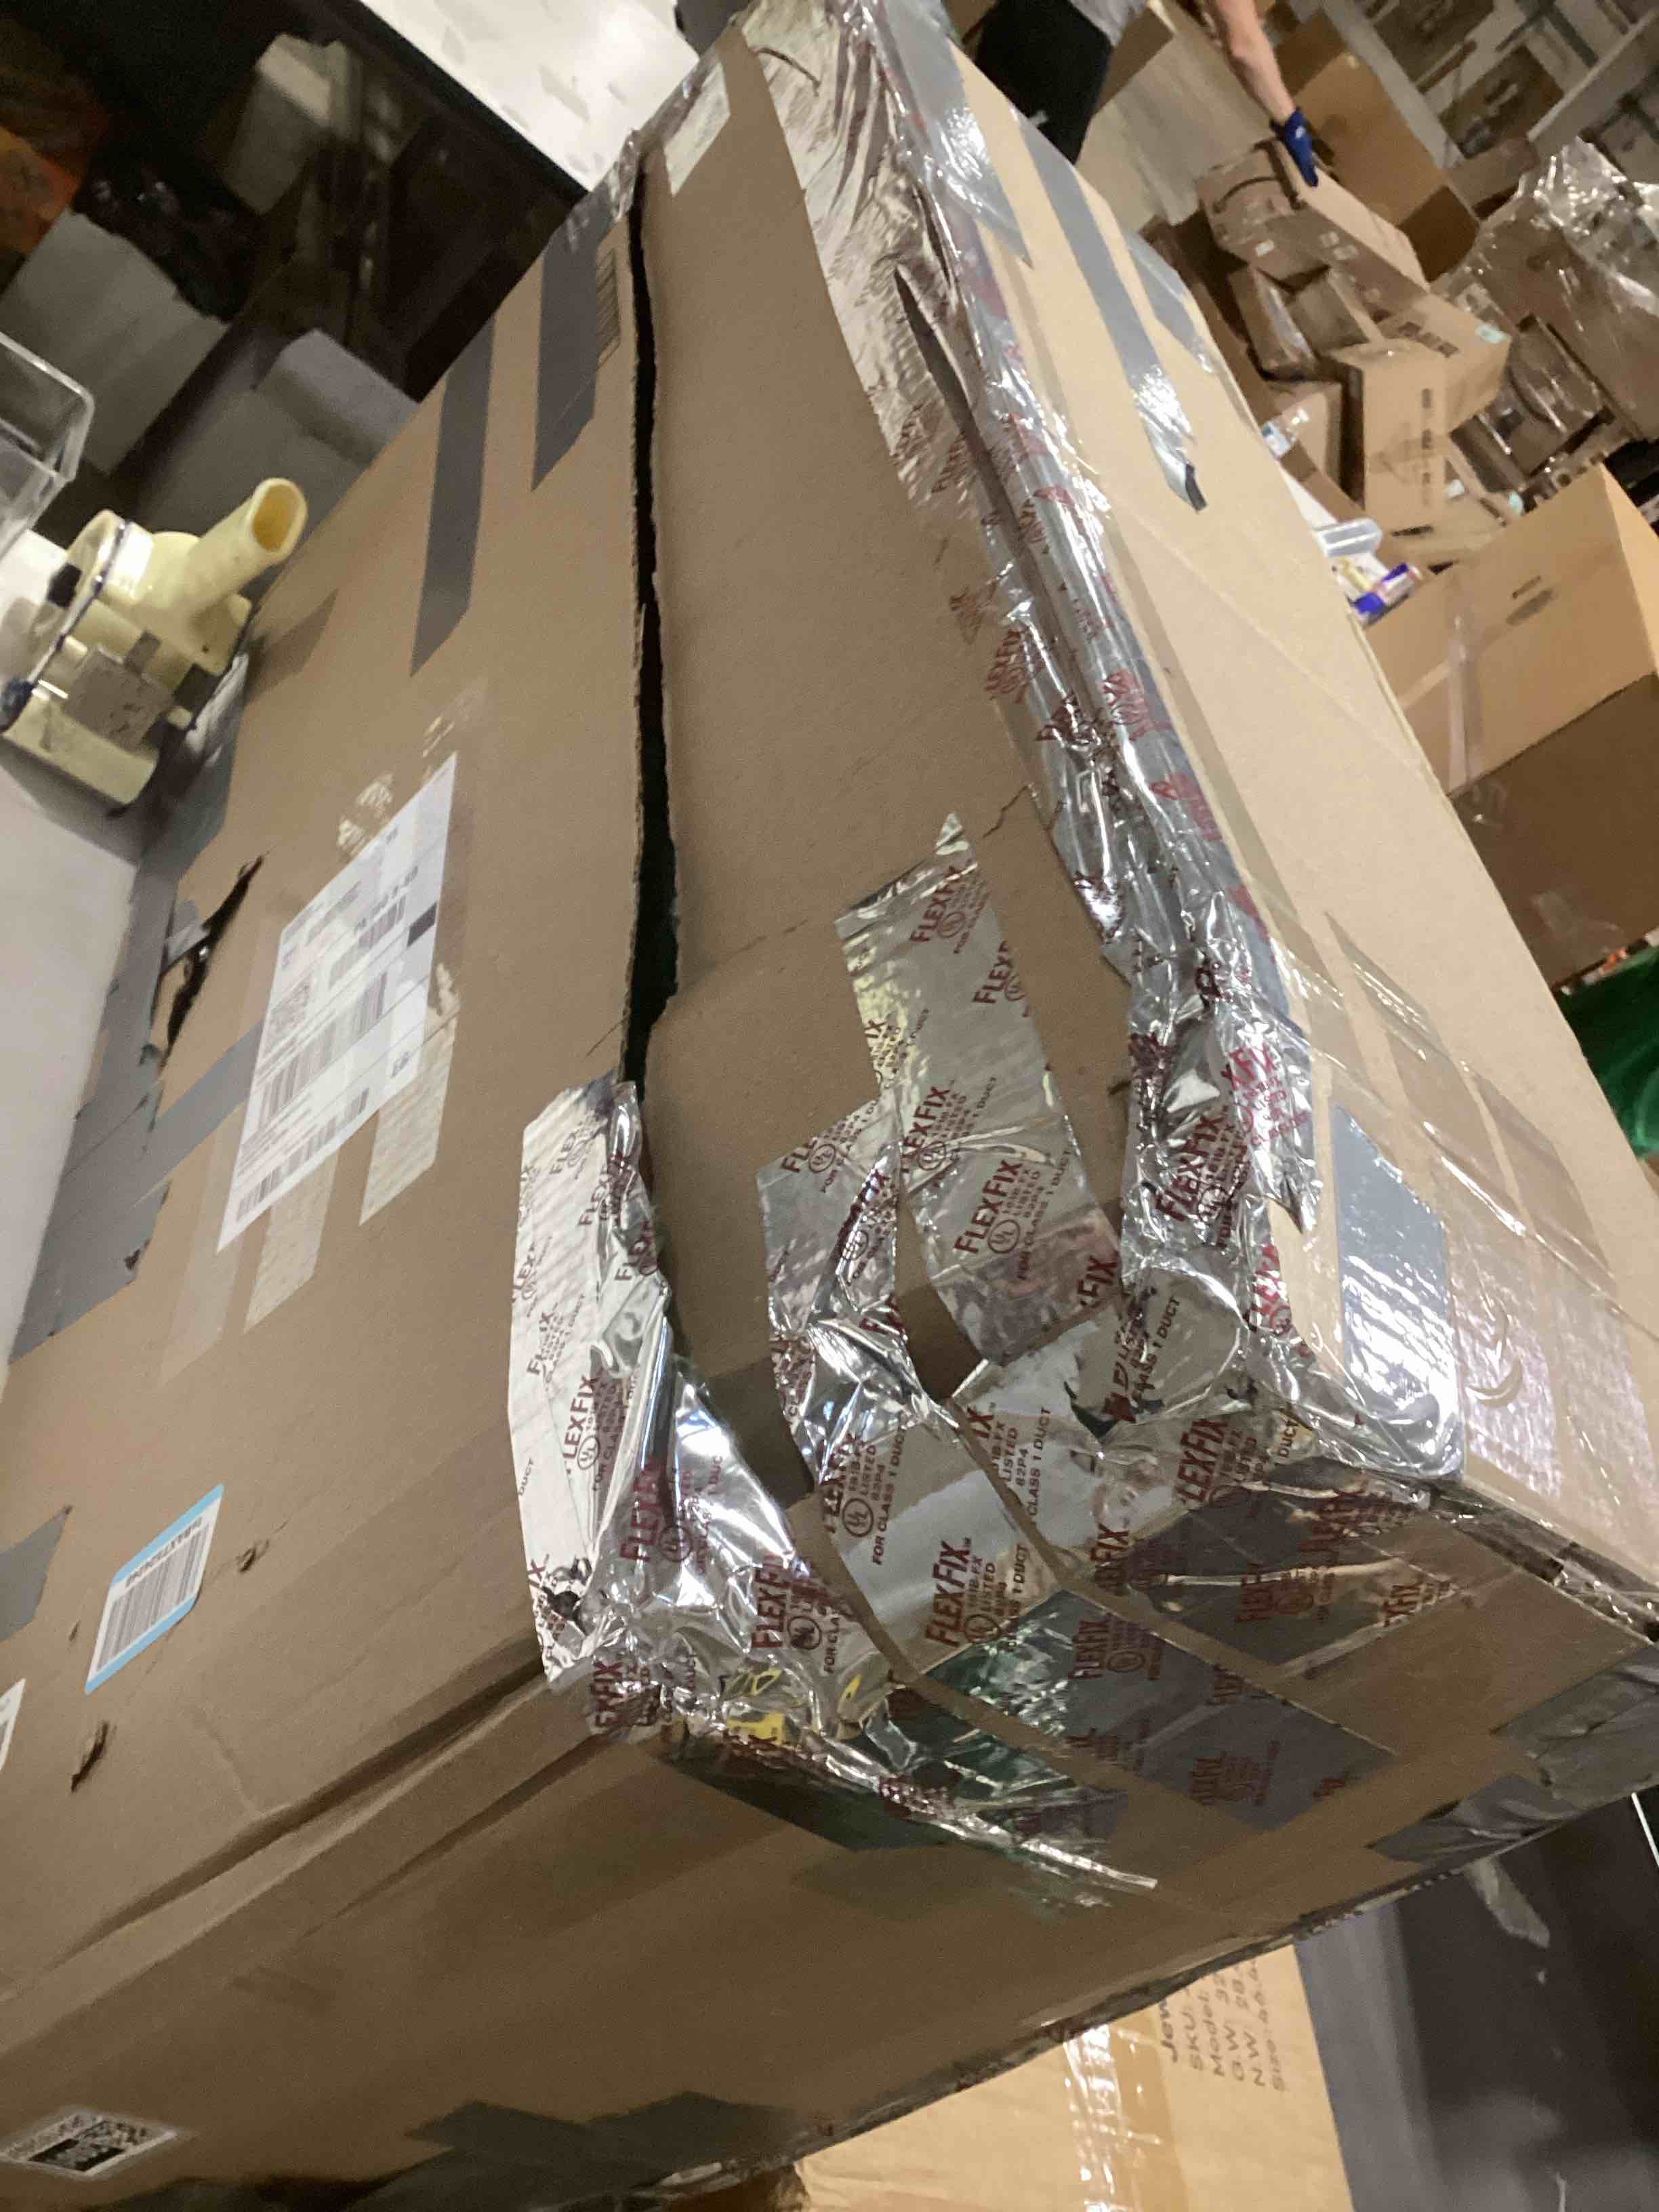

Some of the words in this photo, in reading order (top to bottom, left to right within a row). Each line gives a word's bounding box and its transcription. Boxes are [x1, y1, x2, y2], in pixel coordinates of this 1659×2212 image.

[901, 1086, 950, 1172] LEXFIX
[954, 1160, 1022, 1254] FLEXFIX
[1156, 1295, 1180, 1339] DUCT
[562, 1375, 598, 1459] LEXFIX
[1033, 1406, 1051, 1450] DUCT
[999, 1427, 1018, 1481] LISTED
[1016, 1448, 1029, 1486] 82P4
[1176, 1418, 1227, 1502] LEXFIX
[878, 1483, 894, 1532] CLASS
[1027, 1469, 1041, 1516] CLASS
[872, 1535, 885, 1565] FOR
[1013, 1544, 1030, 1584] DUCT
[751, 1555, 791, 1648] FLEXFI
[925, 1540, 970, 1647] FLEXFIX
